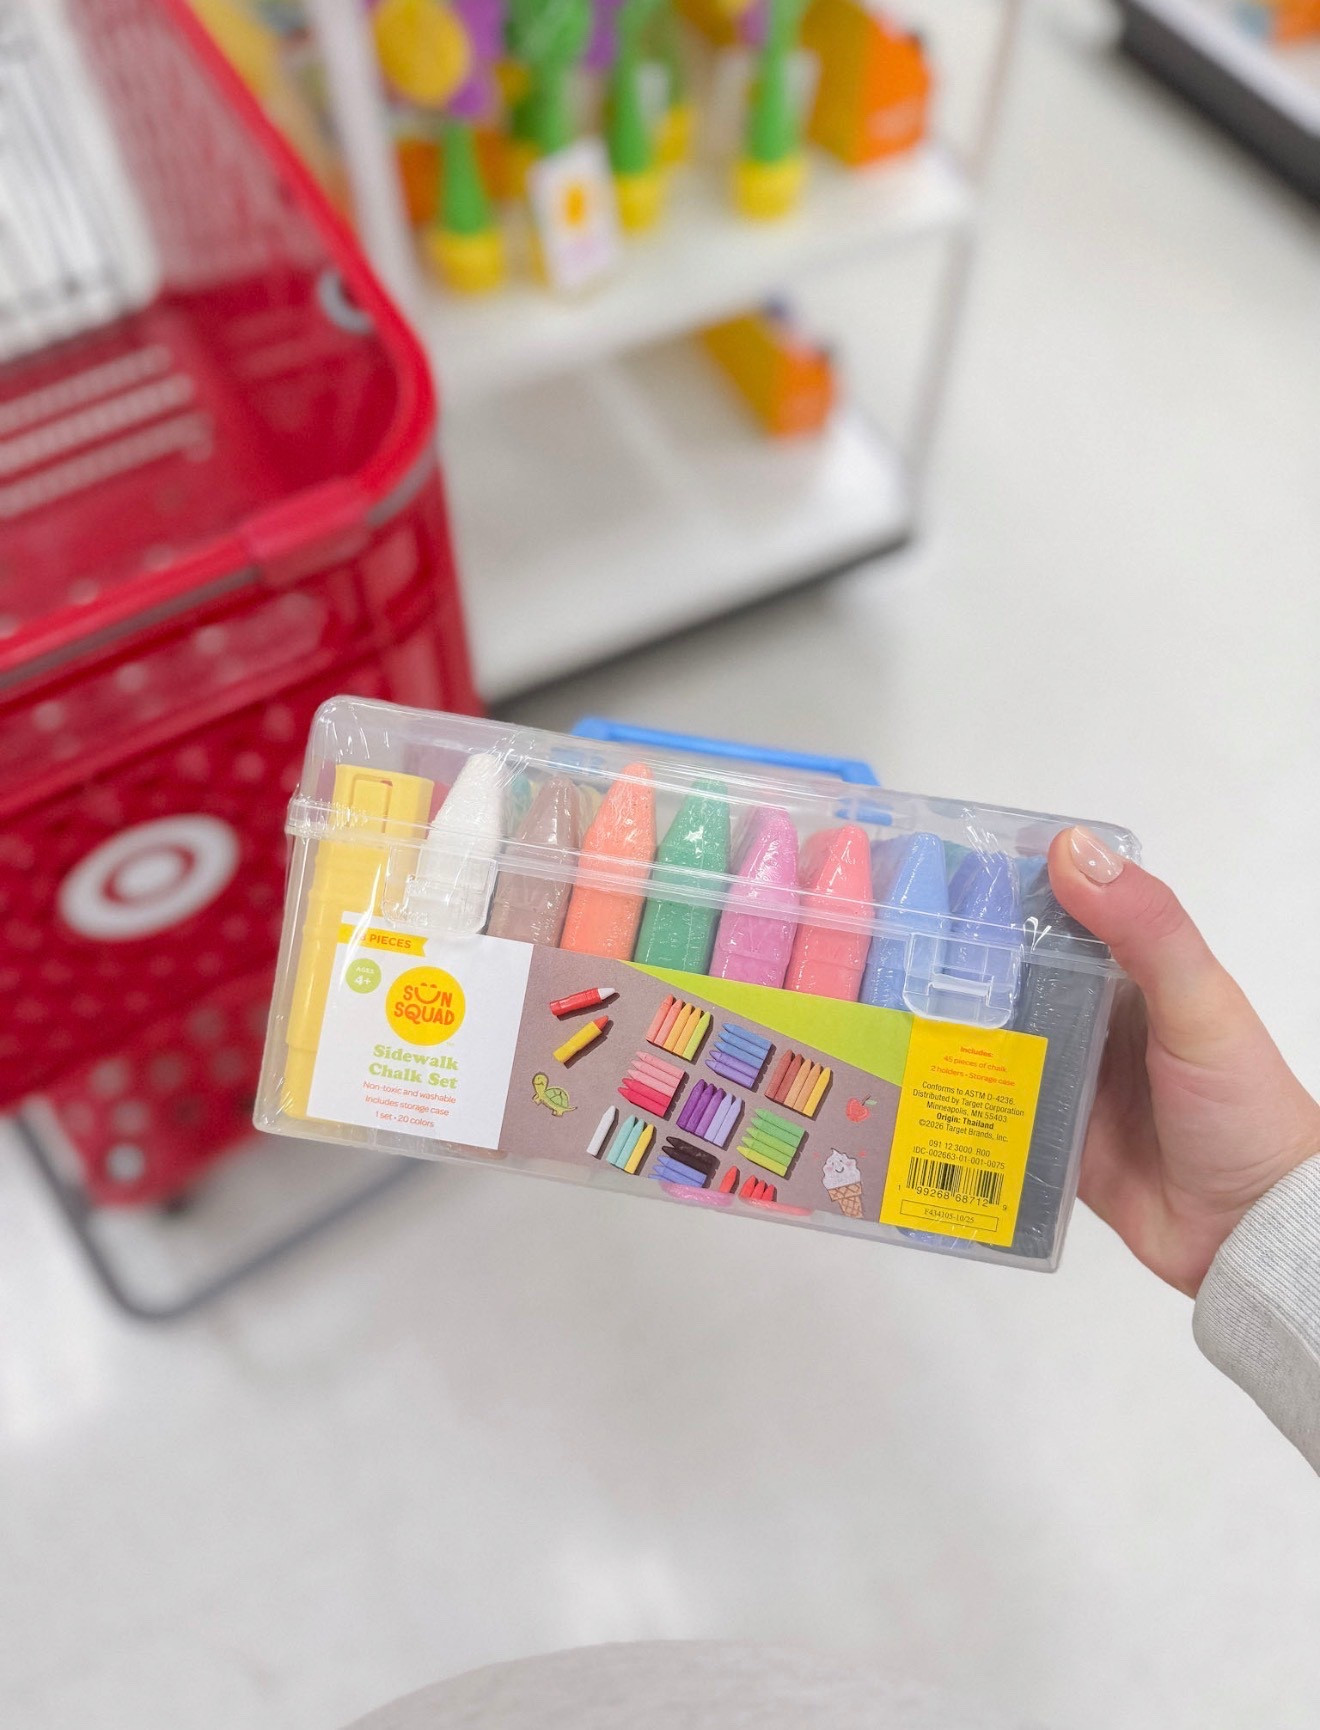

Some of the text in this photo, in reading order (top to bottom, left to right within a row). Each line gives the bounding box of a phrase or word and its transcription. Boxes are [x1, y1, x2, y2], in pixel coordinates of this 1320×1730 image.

[369, 934, 412, 949] PIECES
[354, 975, 371, 985] 4+
[403, 984, 453, 1008] SUN
[394, 1001, 455, 1026] SQUAD
[373, 1044, 459, 1071] Sidewalk
[960, 1046, 994, 1058] Includes:
[944, 1055, 953, 1063] 45
[953, 1058, 977, 1068] pieces
[988, 1063, 1007, 1072] chalk
[369, 1062, 458, 1089] Chalk Set
[937, 1066, 964, 1077] holders
[969, 1072, 997, 1084] Storage
[998, 1078, 1016, 1086] case
[363, 1081, 456, 1104] Non-toxic and washable
[912, 1089, 1025, 1116] Distributed by Target Corporation
[922, 1081, 1016, 1105] Conforms to ASTM D-4236.
[365, 1095, 449, 1116] Includes storage case
[926, 1101, 1008, 1122] Minneapolis, MN 55403
[397, 1114, 408, 1123] 20
[410, 1116, 435, 1127] colors
[919, 1118, 944, 1130] ©2026
[945, 1123, 967, 1135] Target
[968, 1127, 994, 1140] Brands,
[936, 1112, 995, 1130] Origin: Thailand
[928, 1139, 942, 1148] 091
[945, 1141, 953, 1149] 12
[954, 1143, 973, 1153] 3000
[916, 1186, 950, 1200] 99268
[955, 1194, 989, 1208] 68712
